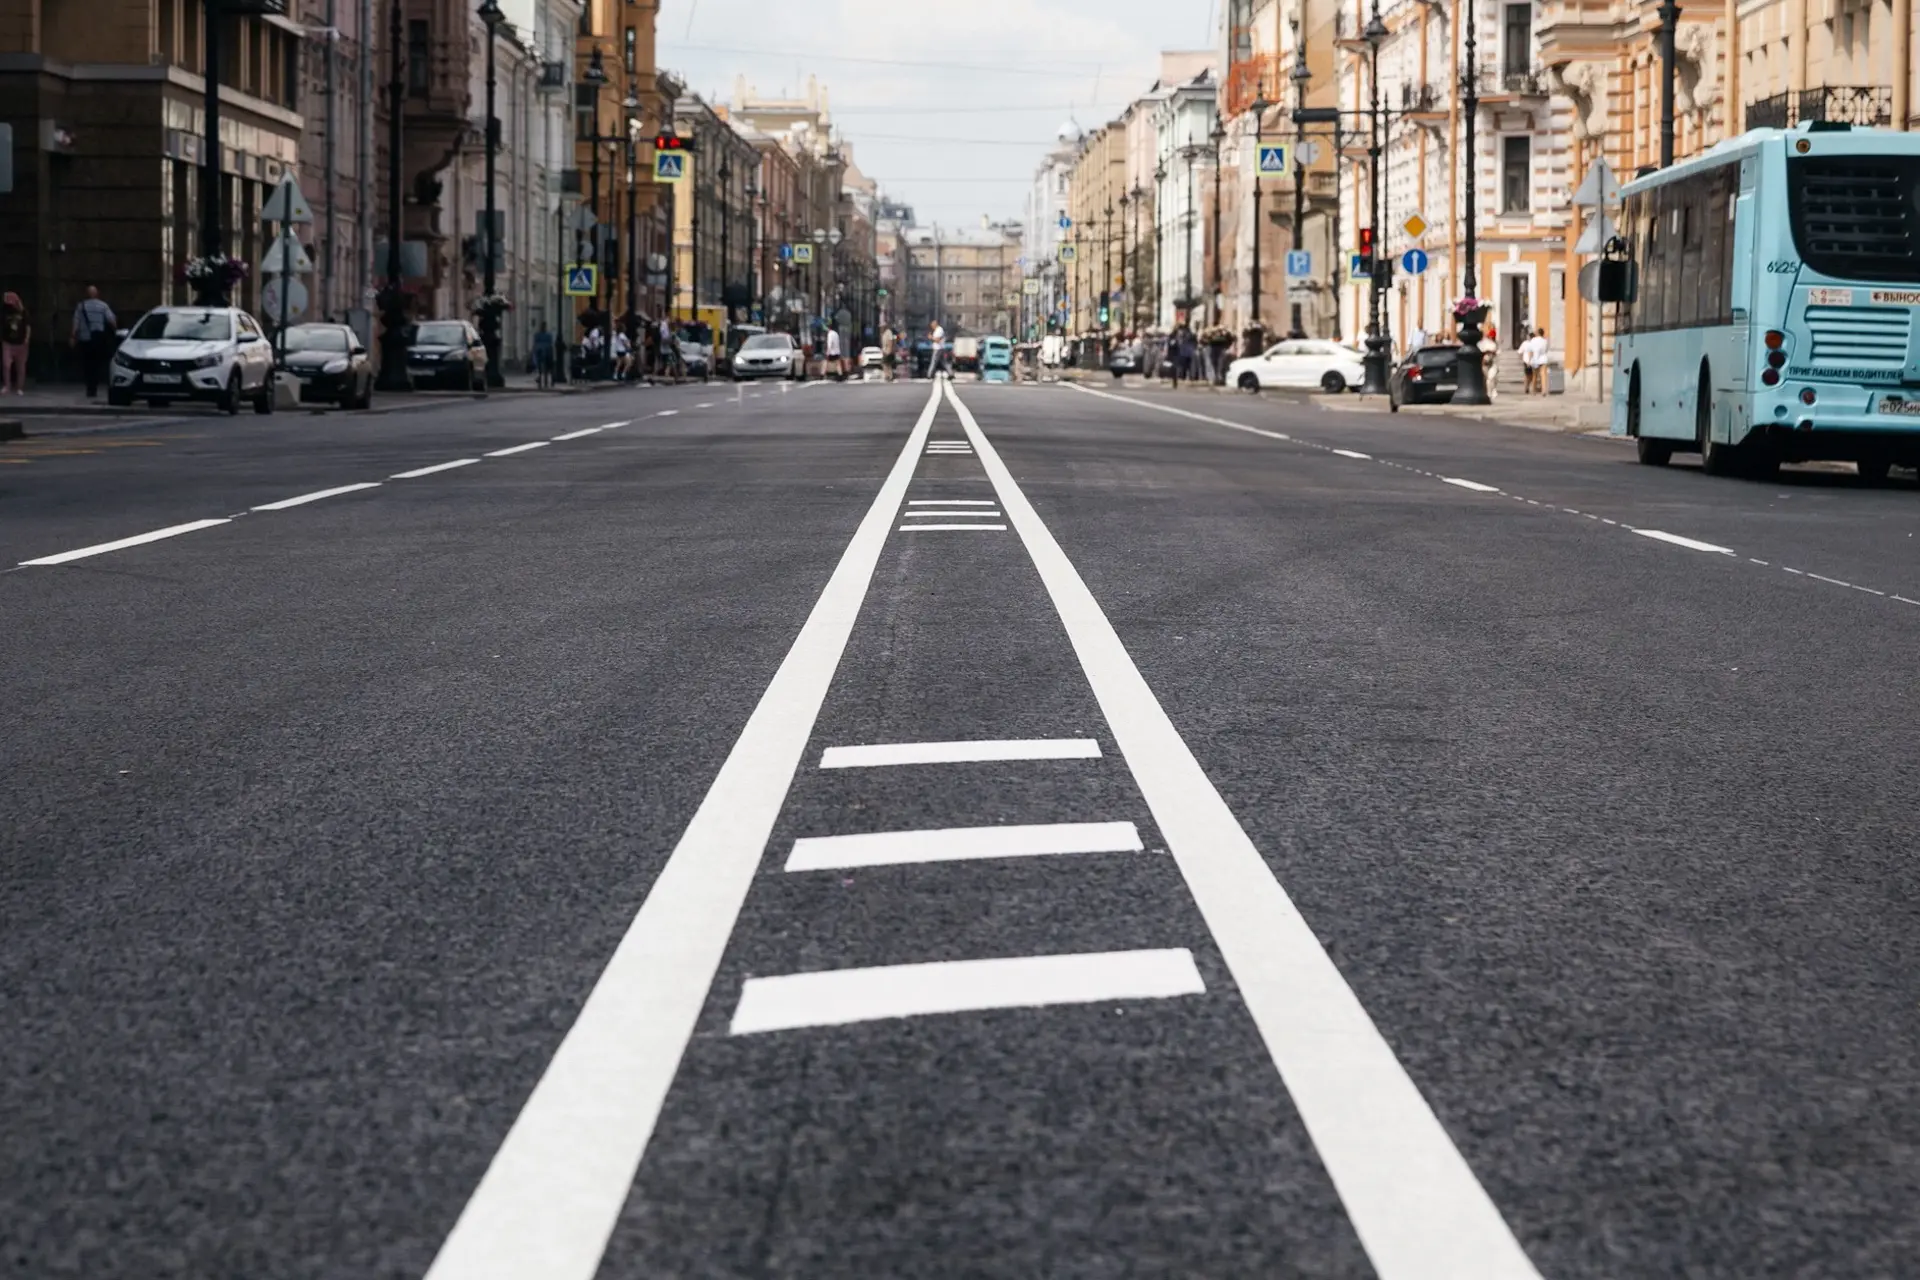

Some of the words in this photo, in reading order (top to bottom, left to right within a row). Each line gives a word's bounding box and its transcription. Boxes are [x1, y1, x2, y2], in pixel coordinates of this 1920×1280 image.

[1767, 261, 1798, 274] 6225
[1883, 291, 1920, 304] ВЫНОС
[1789, 366, 1850, 378] ПРИГЛАШАЕМ
[1853, 369, 1904, 380] ВОДИТЕЛЕЙ
